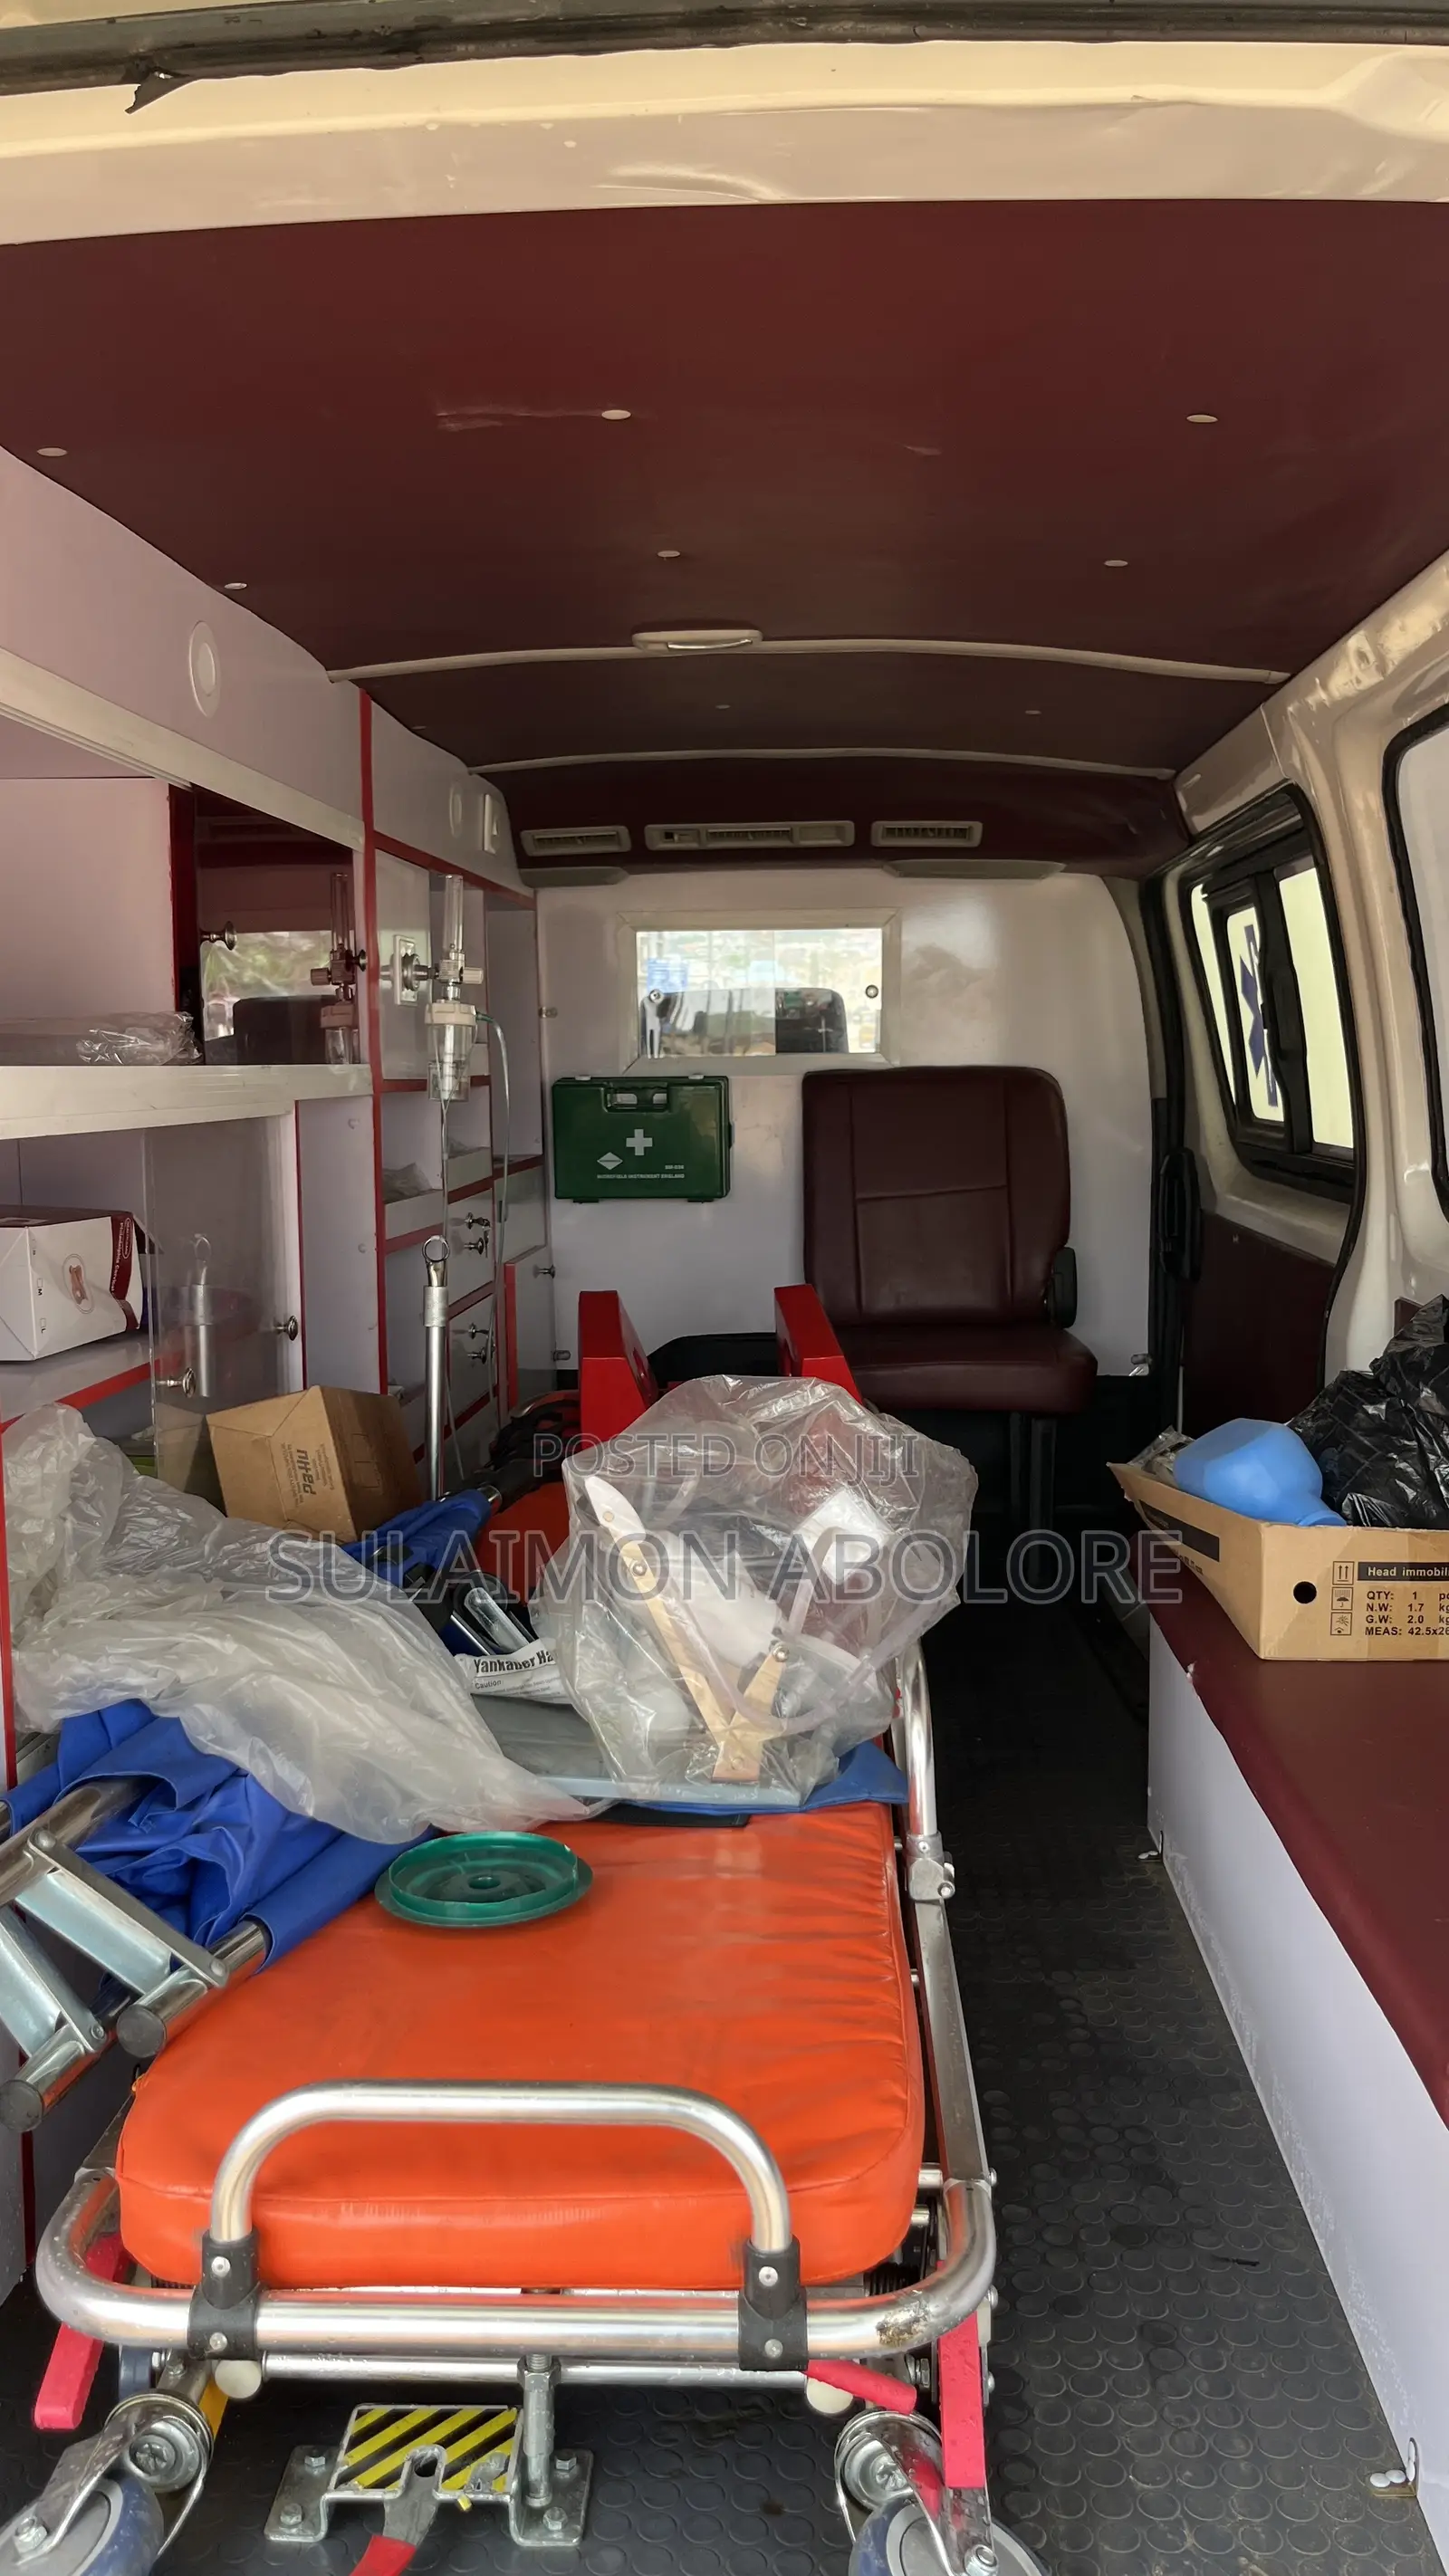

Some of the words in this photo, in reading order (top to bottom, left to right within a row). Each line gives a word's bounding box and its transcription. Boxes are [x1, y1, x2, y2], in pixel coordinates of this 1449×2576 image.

[1367, 1566, 1396, 1576] Head
[1367, 1591, 1395, 1601] QTY:
[1412, 1591, 1417, 1600] 1
[1366, 1603, 1393, 1612] N.W:
[1407, 1603, 1425, 1612] 1.7
[1366, 1614, 1393, 1623] G.W:
[1407, 1614, 1425, 1623] 2.0
[1365, 1626, 1402, 1636] MEAS:
[475, 1680, 502, 1690] Caution
